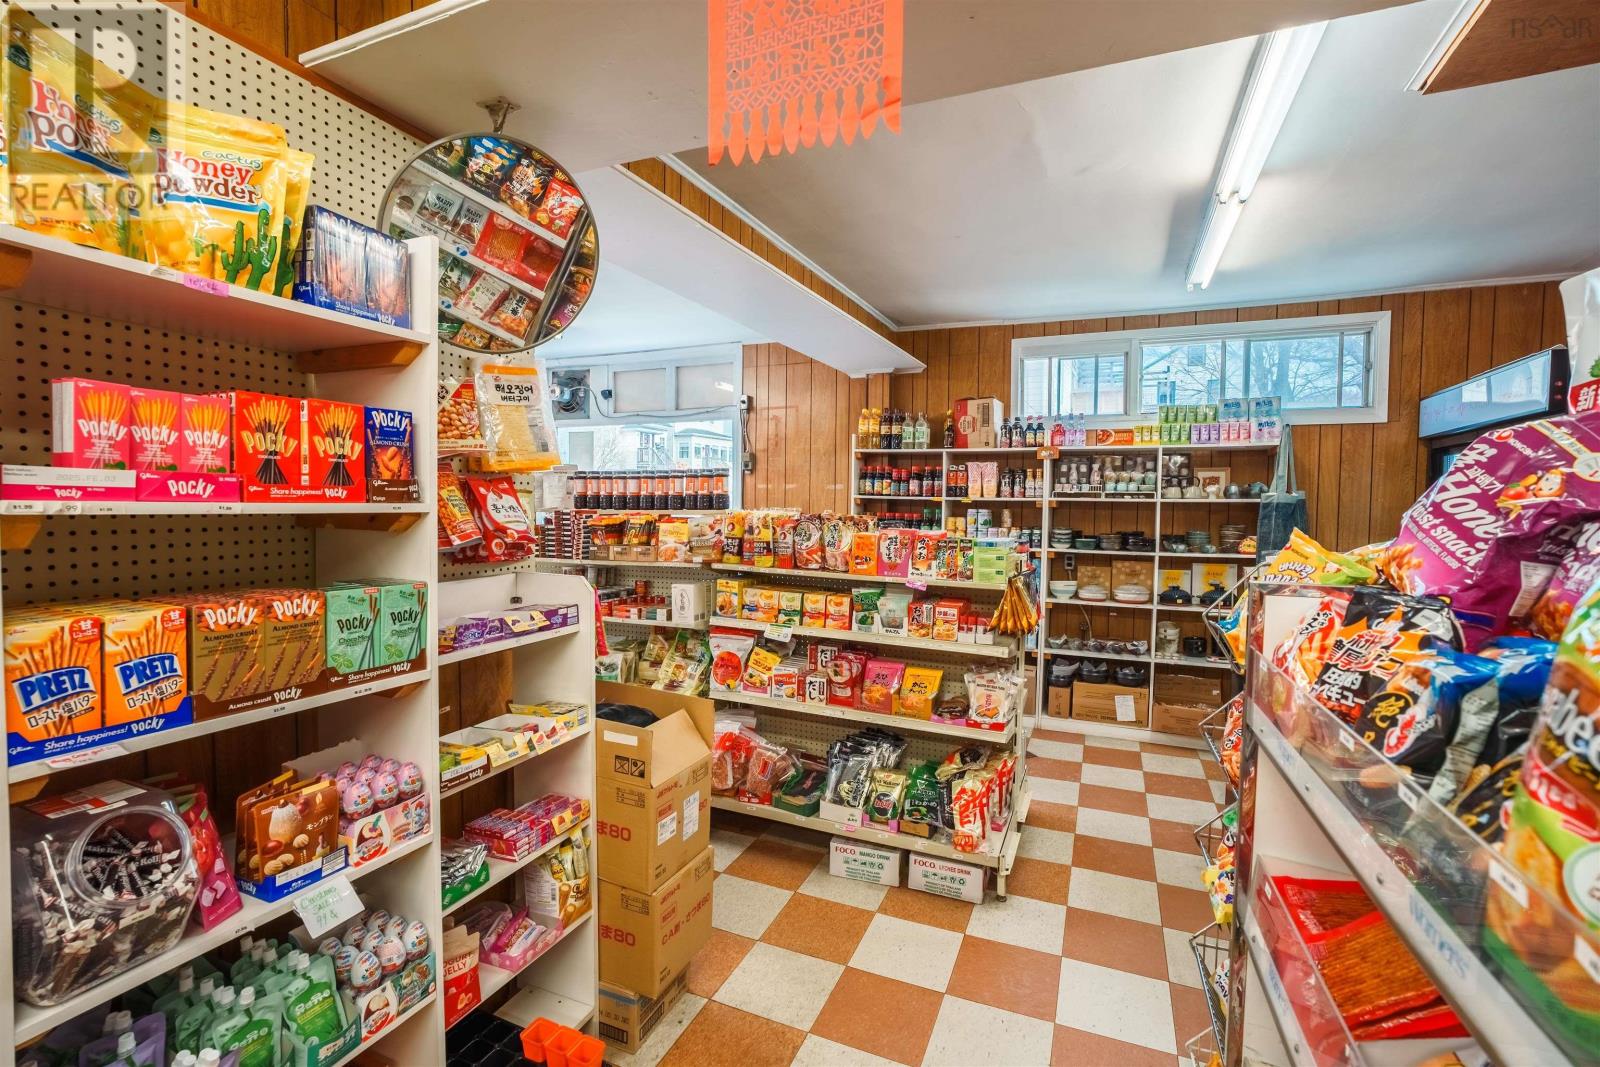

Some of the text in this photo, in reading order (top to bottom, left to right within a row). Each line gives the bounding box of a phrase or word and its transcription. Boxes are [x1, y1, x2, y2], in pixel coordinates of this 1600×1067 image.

[270, 487, 290, 495] Share
[290, 488, 324, 496] happiness!
[118, 655, 178, 690] PRETZ
[19, 668, 90, 707] PRETZ
[44, 737, 76, 751] Share
[77, 726, 128, 744] happiness!
[835, 845, 856, 856] FOCO
[913, 858, 936, 869] FOCO
